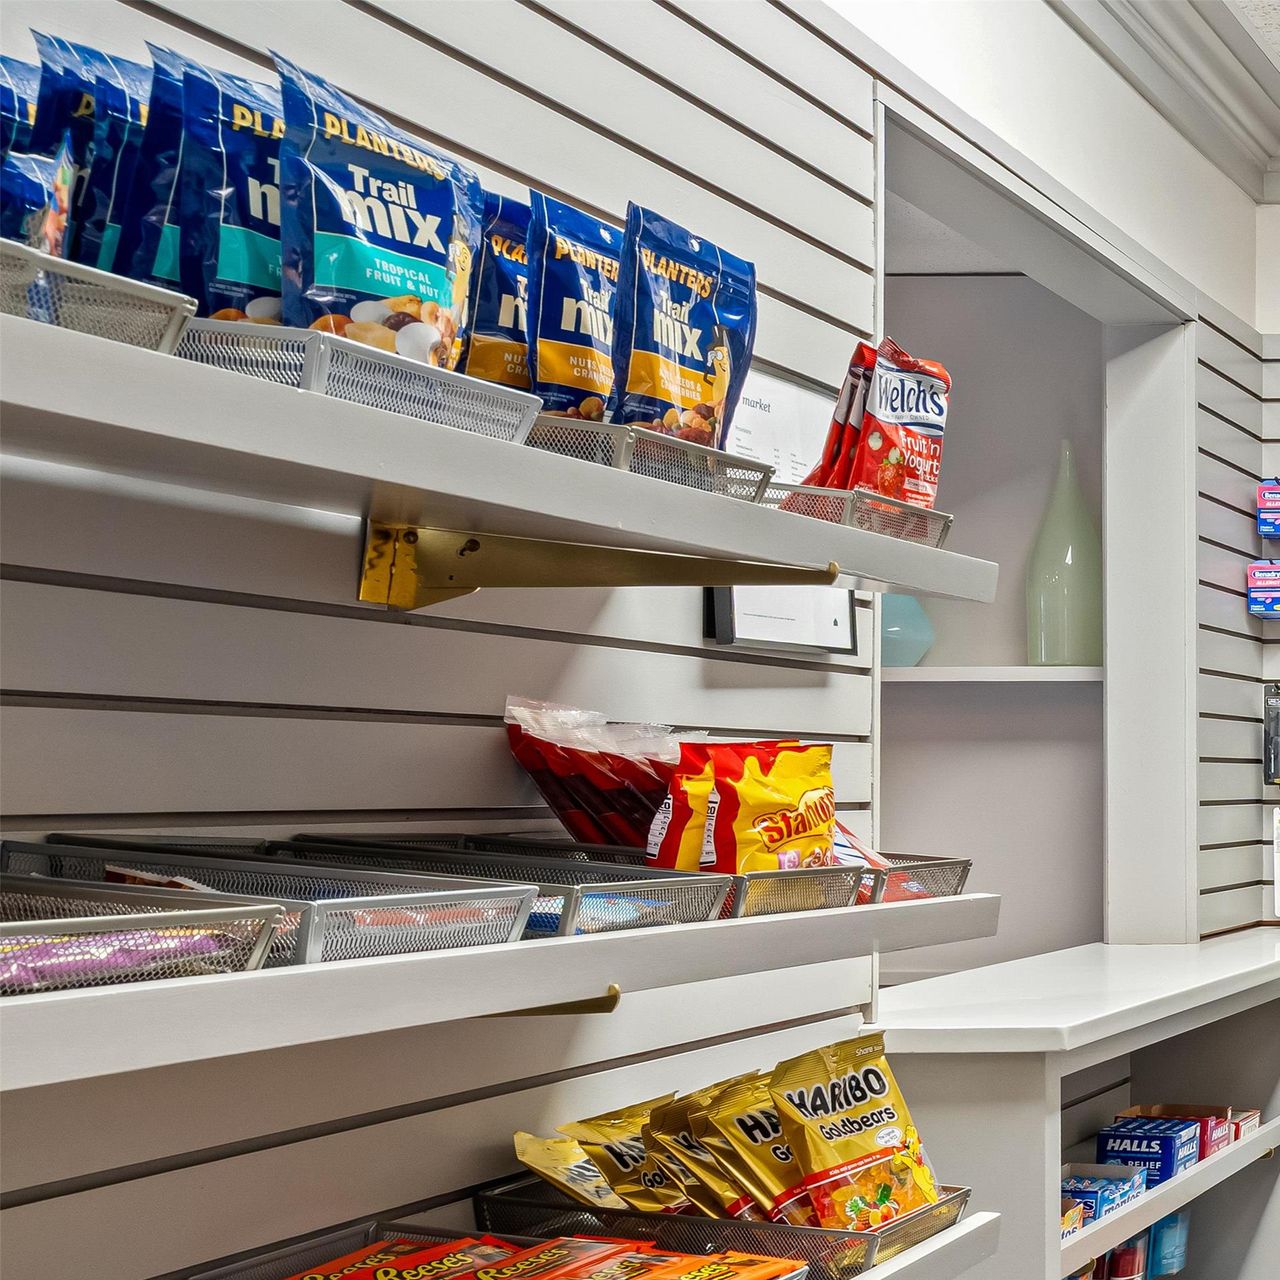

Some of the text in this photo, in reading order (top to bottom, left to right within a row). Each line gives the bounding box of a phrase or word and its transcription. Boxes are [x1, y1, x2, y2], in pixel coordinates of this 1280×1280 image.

[324, 112, 447, 181] PLANTERS
[348, 164, 417, 209] Trail
[338, 188, 446, 254] mix
[366, 268, 439, 299] FRUIT & NUT
[375, 258, 431, 285] TROPICAL
[642, 248, 712, 298] PLANTERS
[660, 290, 689, 322] Trail
[654, 308, 703, 360] mix
[742, 395, 772, 413] market
[878, 374, 944, 416] Welch's
[900, 430, 926, 450] Fruit
[786, 1068, 887, 1118] HARIBO
[819, 1106, 896, 1141] Goldbears
[1178, 1141, 1196, 1160] HALLS
